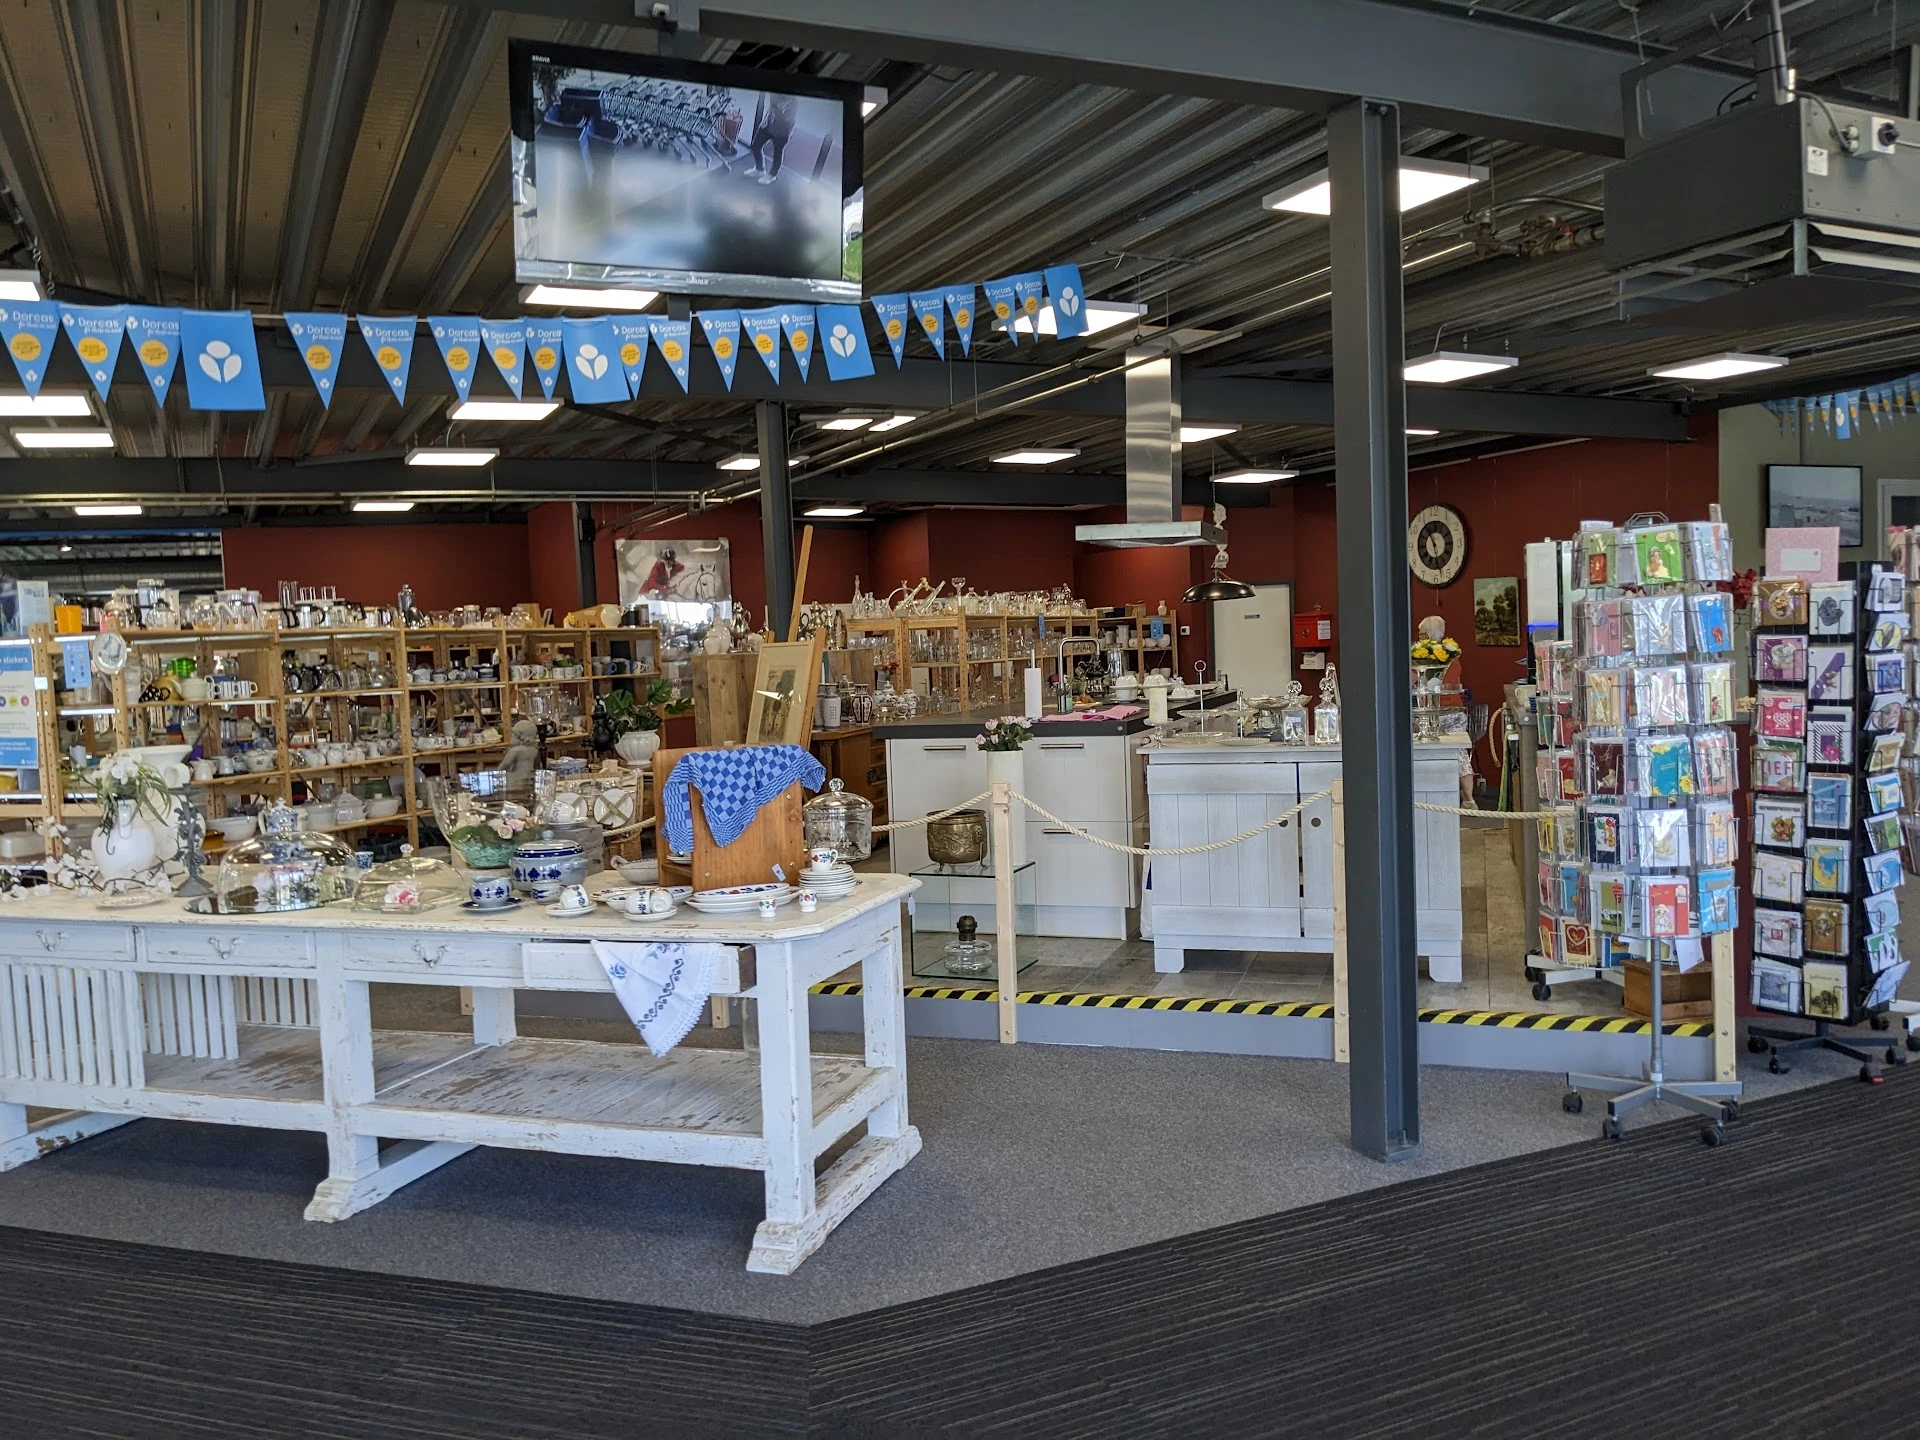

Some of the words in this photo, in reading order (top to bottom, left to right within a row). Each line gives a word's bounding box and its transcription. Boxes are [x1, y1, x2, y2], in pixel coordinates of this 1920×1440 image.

[13, 310, 54, 323] Dorcas
[792, 314, 813, 322] Dorcas
[78, 316, 119, 328] Dorcas
[142, 318, 180, 330] Dorcas
[715, 320, 738, 328] Dorcas
[307, 324, 341, 335] Dorcas
[375, 328, 409, 338] Dorcas
[448, 328, 478, 338] Dorcas
[538, 329, 562, 338] Dorca
[621, 326, 646, 335] Dorcas
[490, 331, 521, 340] Dorcas
[3, 656, 28, 664] stickers
